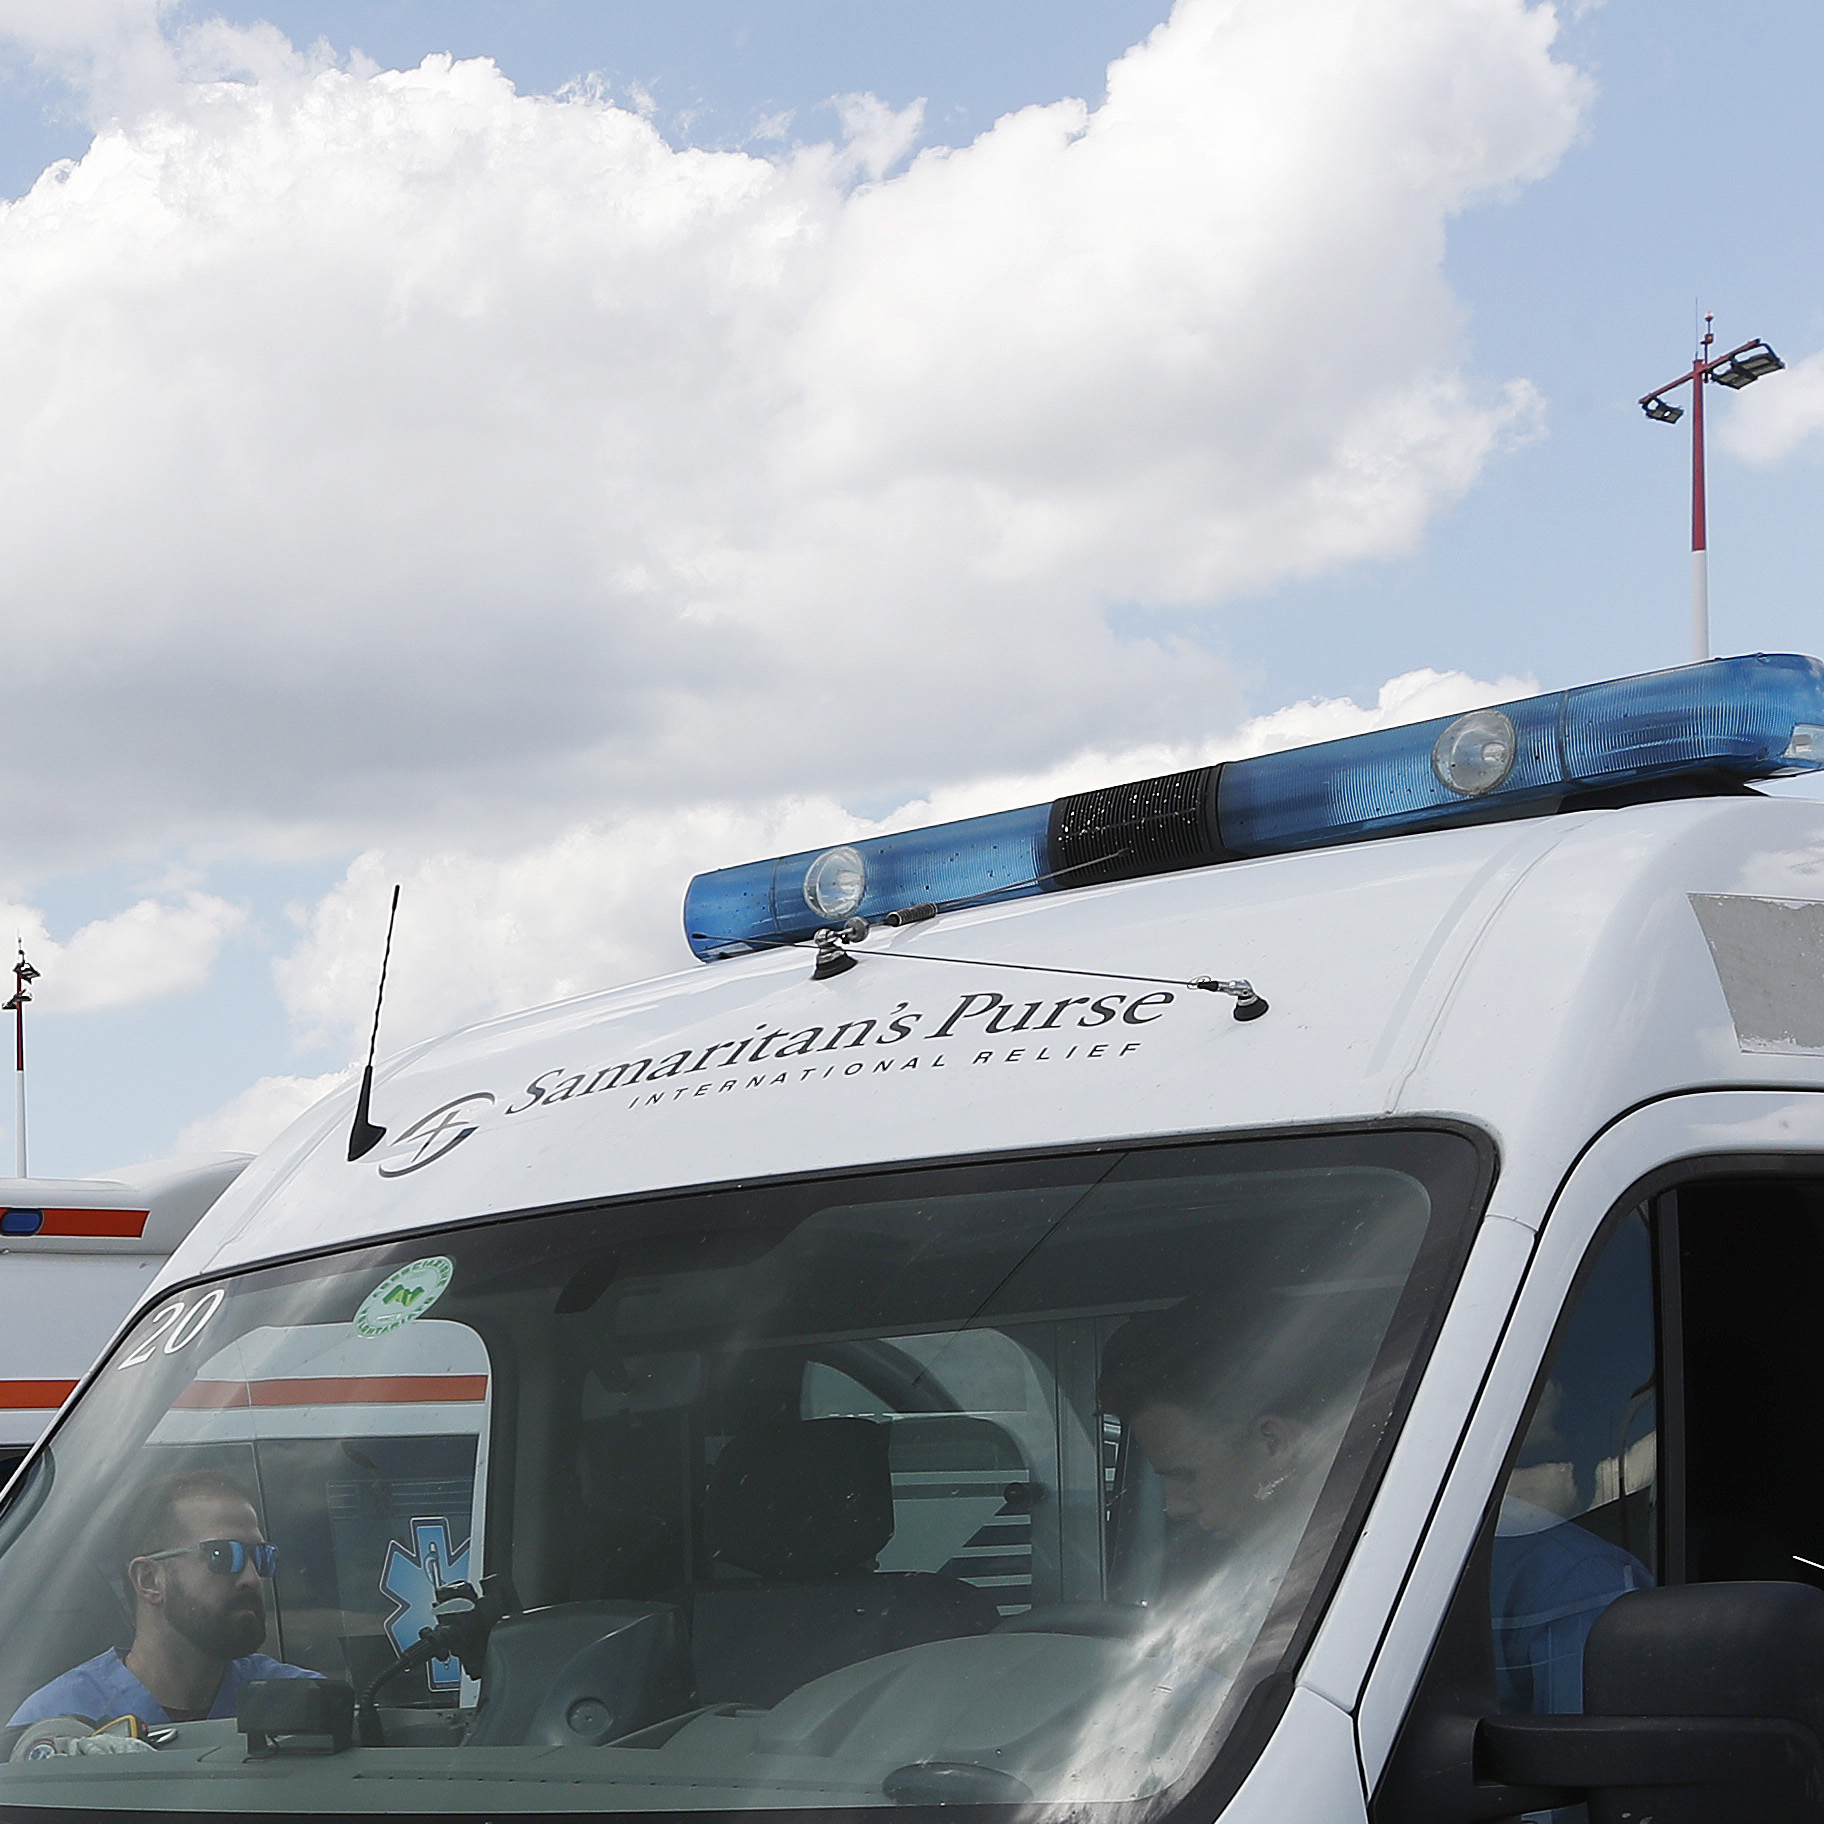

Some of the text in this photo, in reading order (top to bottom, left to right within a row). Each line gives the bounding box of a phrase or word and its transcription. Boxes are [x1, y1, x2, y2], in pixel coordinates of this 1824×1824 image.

[505, 991, 1176, 1115] Samaritan's Purse
[629, 1043, 1141, 1109] INTERNATIONAL RELIEF
[117, 1289, 224, 1370] 20
